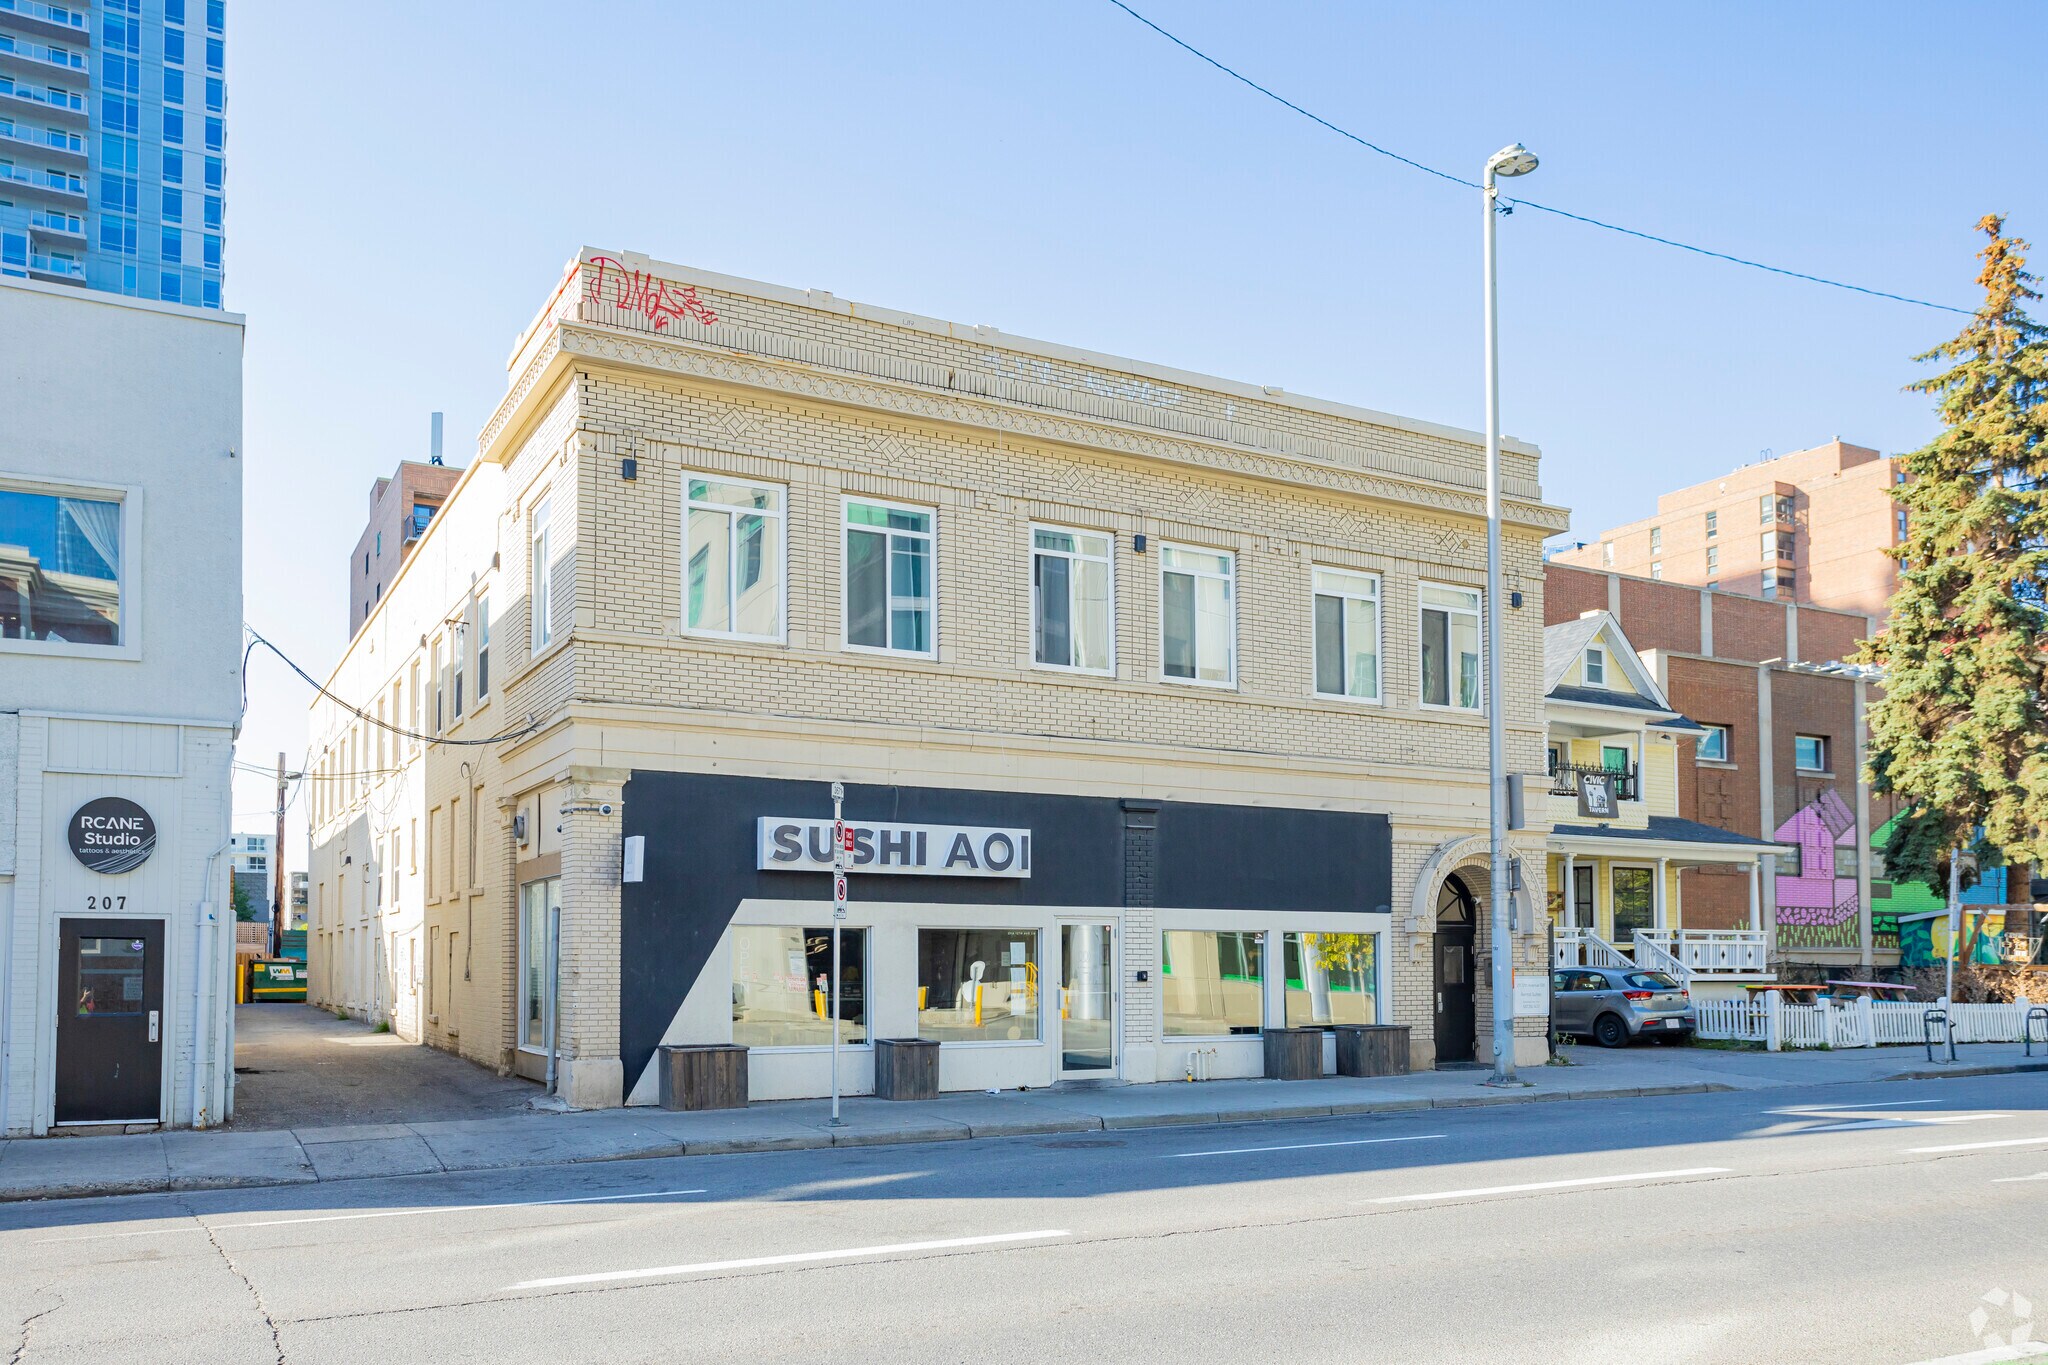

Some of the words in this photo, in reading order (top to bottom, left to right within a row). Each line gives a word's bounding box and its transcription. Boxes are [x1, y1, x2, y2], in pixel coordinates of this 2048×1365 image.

[1583, 774, 1605, 785] CIVIC
[81, 816, 144, 830] RCANE
[84, 832, 141, 846] Studio
[79, 847, 104, 855] tattoos
[769, 824, 927, 867] SUSHI
[943, 831, 1030, 872] AOI
[87, 896, 127, 910] 207
